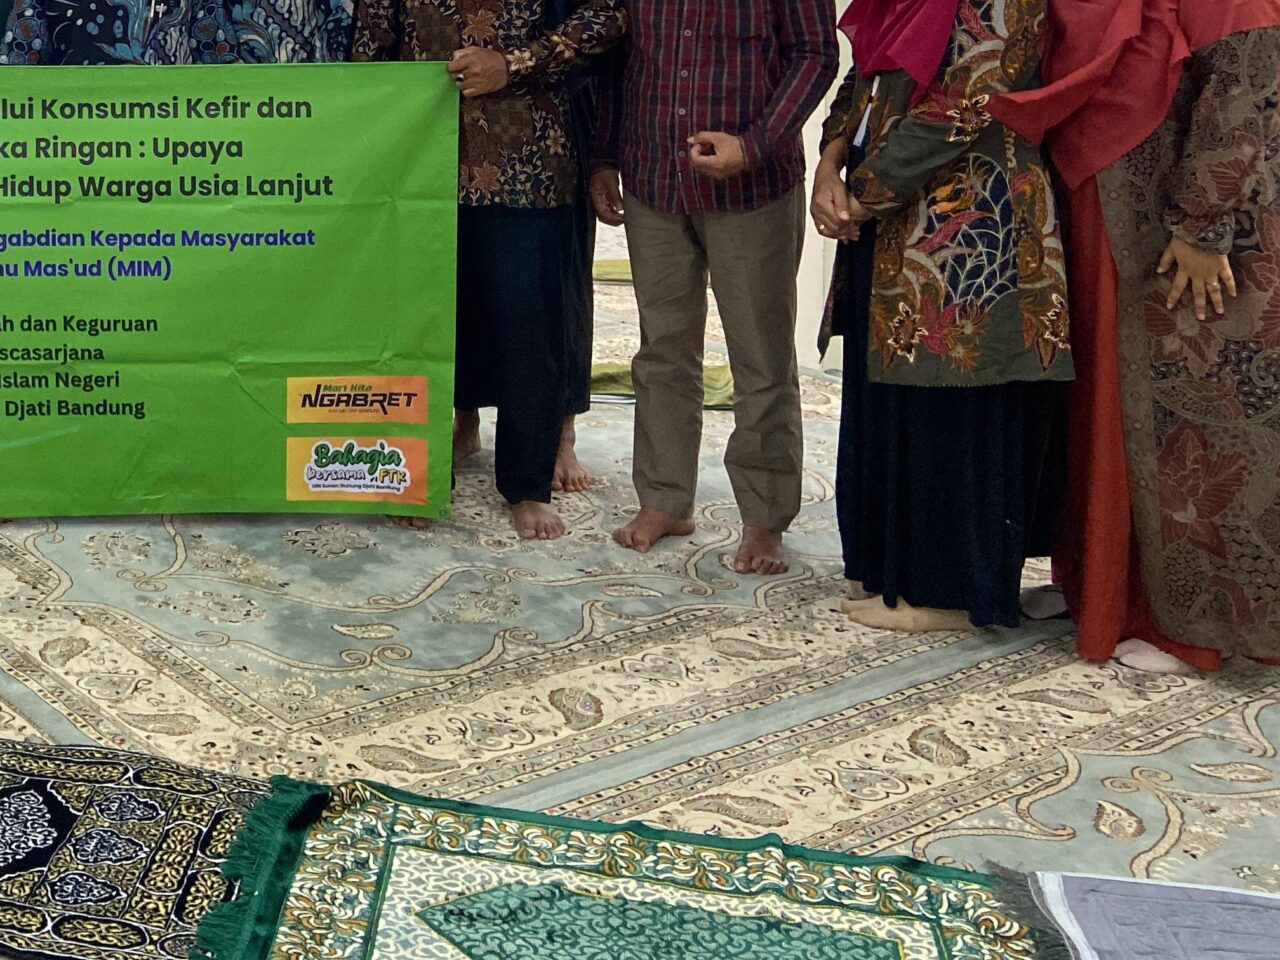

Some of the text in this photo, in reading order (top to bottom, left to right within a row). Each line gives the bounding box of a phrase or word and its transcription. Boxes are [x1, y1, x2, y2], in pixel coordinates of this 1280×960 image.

[41, 96, 179, 120] Konsumsi
[186, 95, 251, 119] Kefir
[256, 96, 312, 119] dan
[35, 134, 132, 166] Ringan
[152, 137, 243, 166] Upaya
[77, 176, 172, 204] Warga
[179, 173, 239, 197] Usia
[246, 172, 334, 203] Lanjut
[90, 229, 176, 252] Kepada
[181, 228, 316, 252] Masyarakat
[23, 257, 102, 277] Mas'ud
[107, 256, 172, 280] (MIM)
[19, 314, 57, 332] dan
[63, 315, 158, 337] Keguruan
[54, 370, 120, 393] Negeri
[4, 399, 52, 422] Djati
[57, 398, 146, 420] Bandung
[301, 384, 418, 416] NGABRET
[314, 442, 403, 475] Bahagia
[306, 467, 407, 485] bersama FTK
